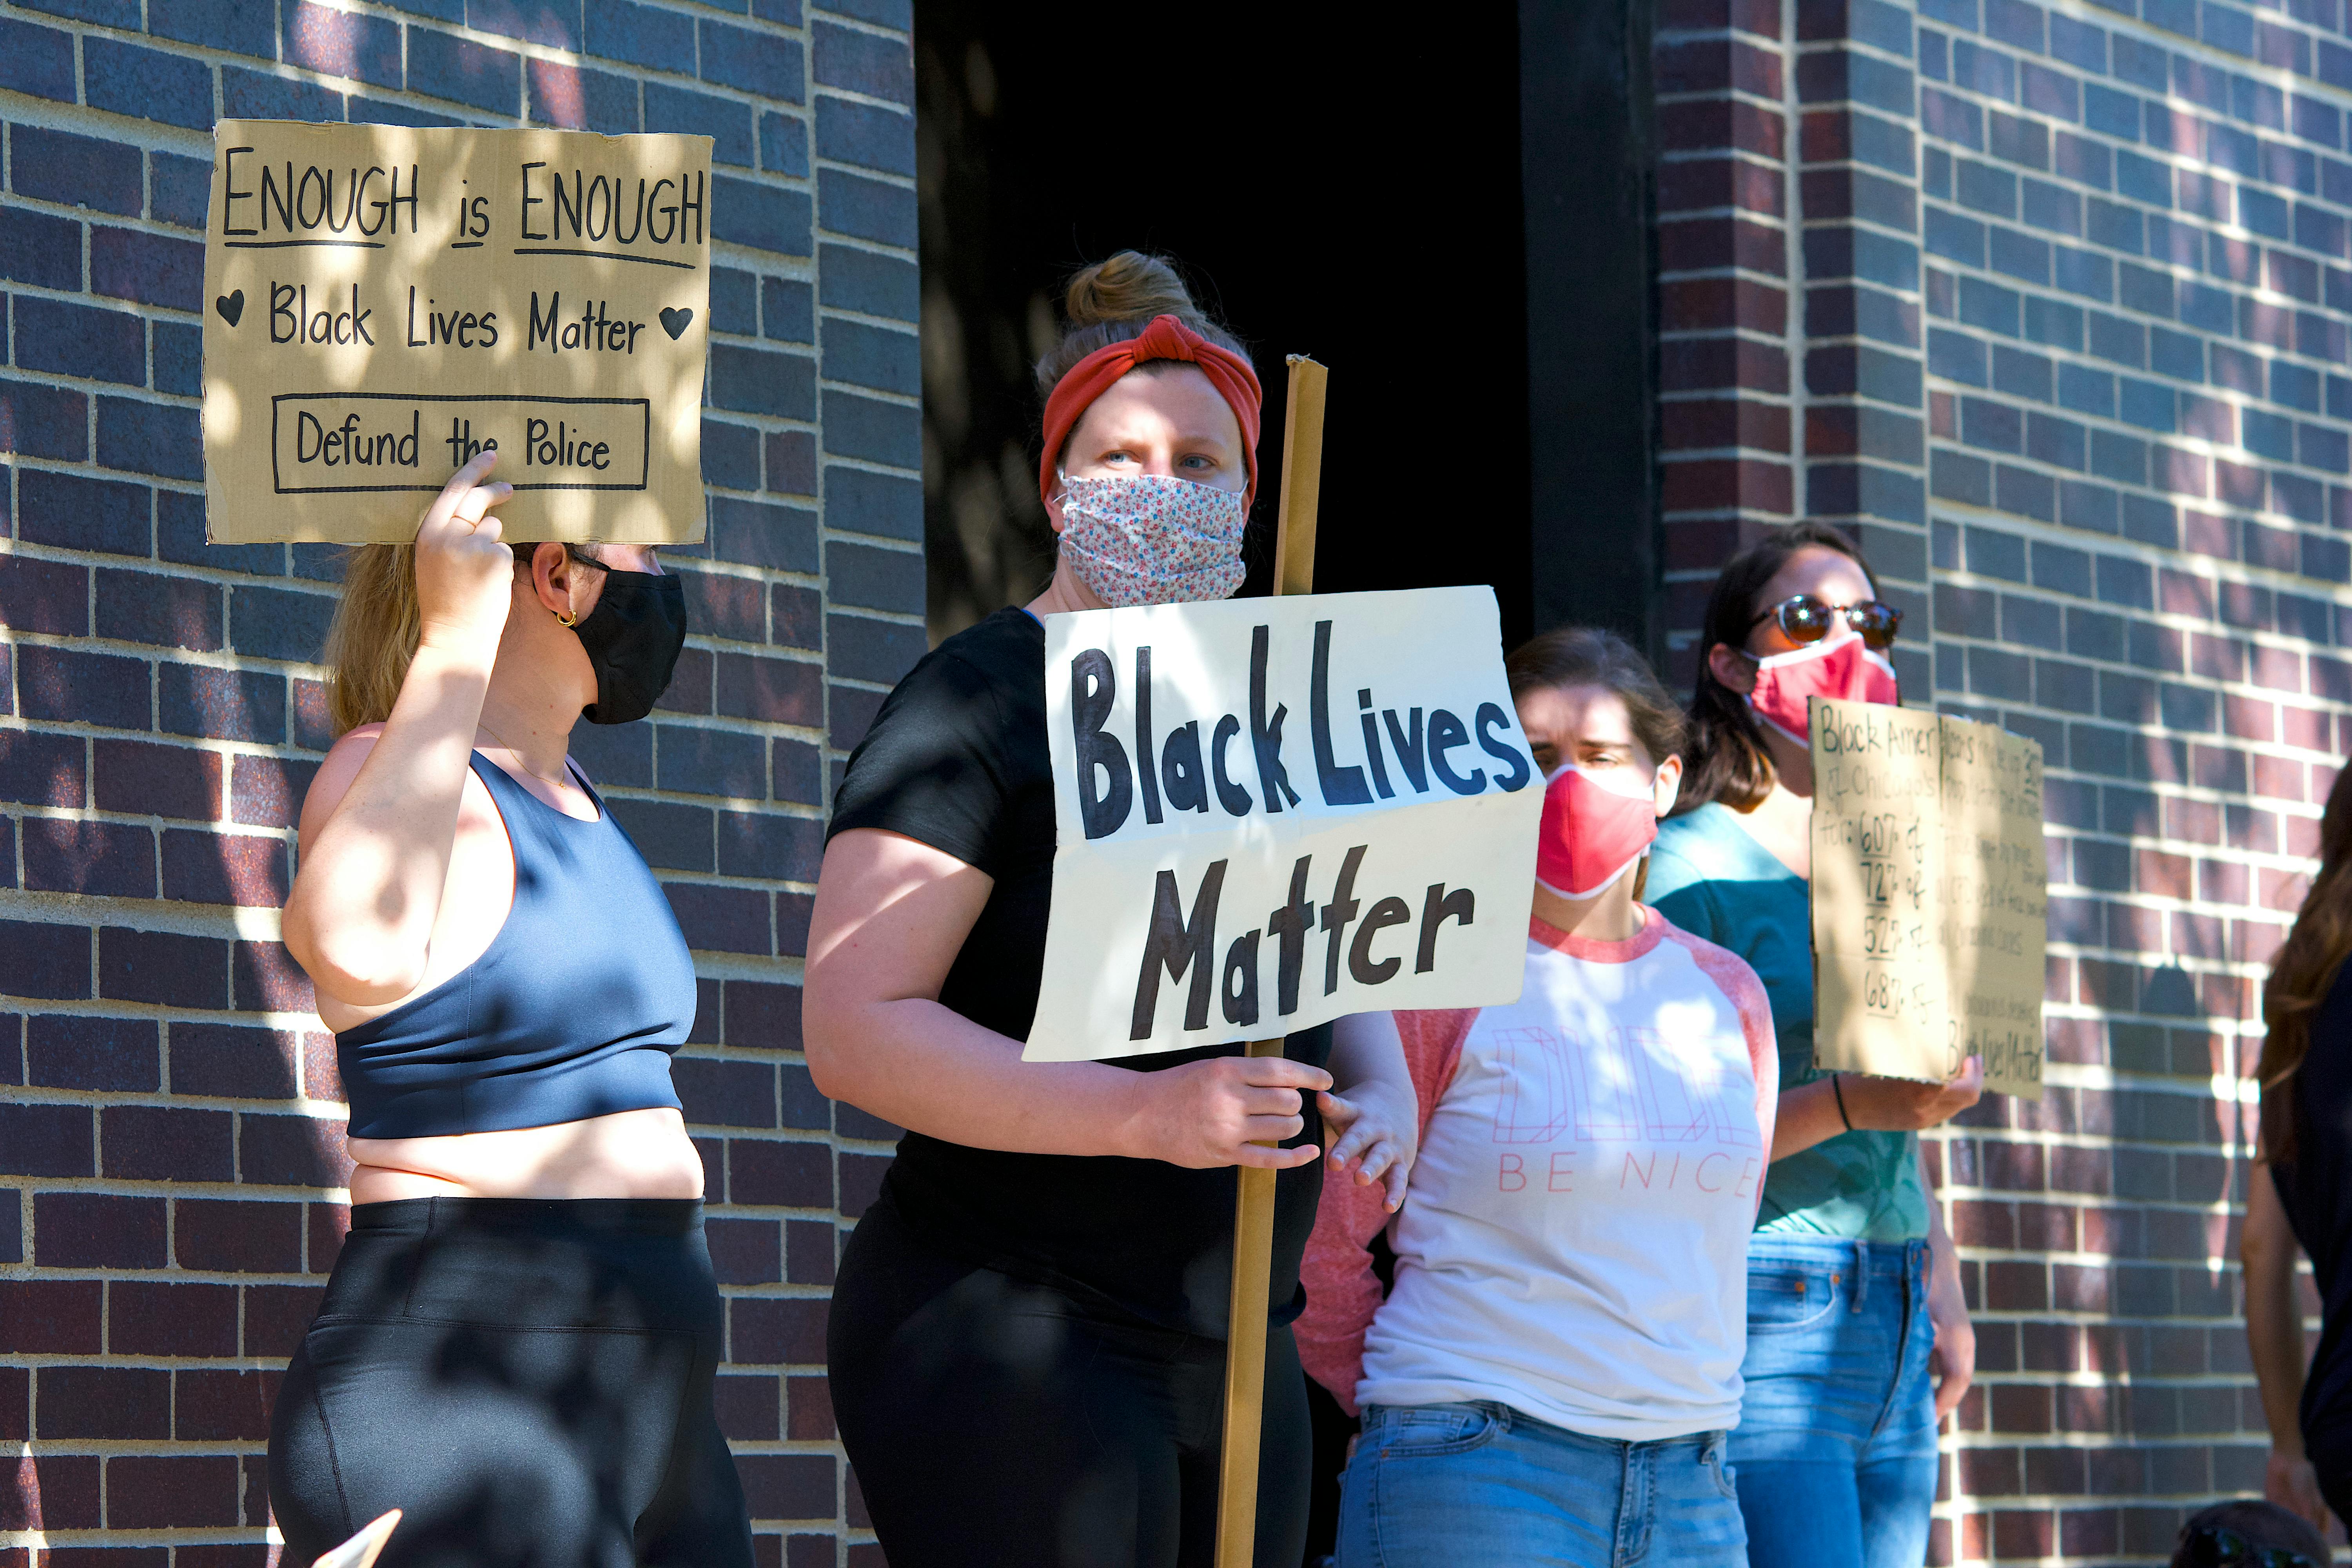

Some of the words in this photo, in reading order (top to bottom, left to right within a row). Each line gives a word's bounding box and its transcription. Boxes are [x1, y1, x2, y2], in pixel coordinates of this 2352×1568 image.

[223, 147, 418, 236] ENOUGH
[459, 179, 490, 238] is
[521, 162, 703, 245] ENOUGH
[270, 281, 375, 347] Black
[407, 285, 498, 348] Lives
[528, 290, 646, 354] Matter
[297, 410, 419, 468] Defund
[445, 417, 498, 468] the
[526, 417, 610, 470] Police
[1071, 625, 1301, 839] Black
[1310, 620, 1530, 806] Lives
[1821, 705, 1882, 756] Black
[1859, 809, 1898, 853] 60%
[1906, 816, 1925, 864] of
[1860, 862, 1898, 901] 72%
[1906, 870, 1926, 910] of
[1129, 844, 1474, 1041] Matter
[1864, 915, 1902, 954] 52%
[1864, 971, 1904, 1014] 68%
[1492, 1026, 1762, 1149] DUDE
[1499, 1151, 1577, 1192] BE
[1620, 1151, 1759, 1198] NICE
